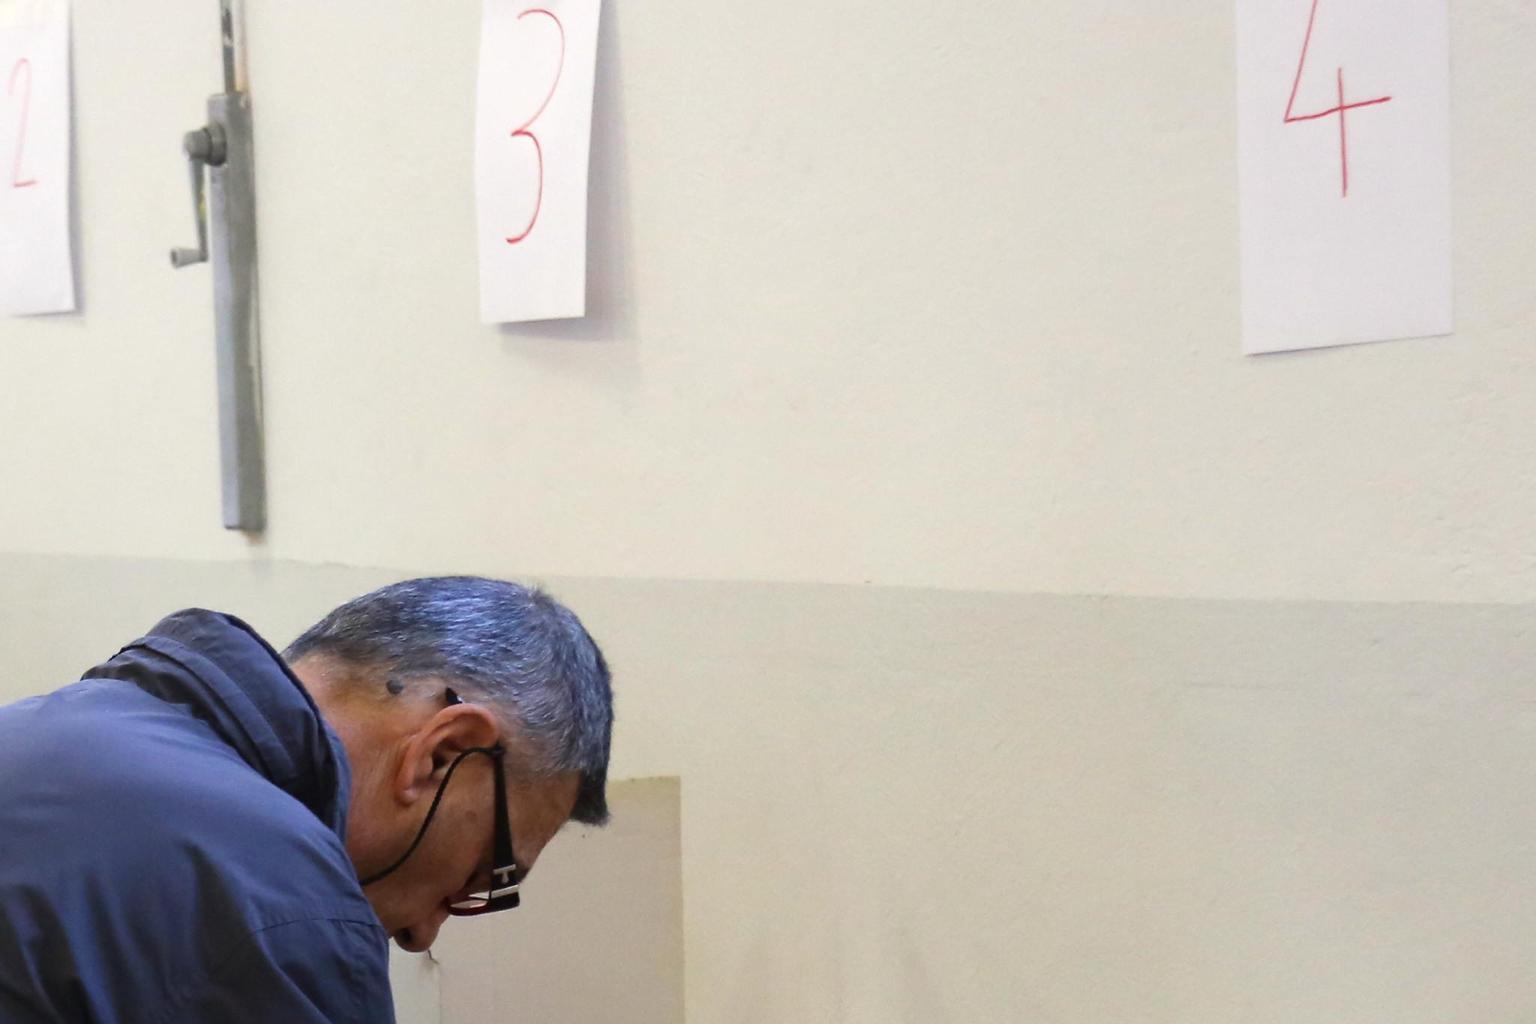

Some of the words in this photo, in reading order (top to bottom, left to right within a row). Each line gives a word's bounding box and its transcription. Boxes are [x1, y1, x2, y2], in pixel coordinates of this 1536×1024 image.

[7, 57, 41, 190] 2
[505, 8, 566, 245] 3
[1282, 0, 1393, 199] 4
